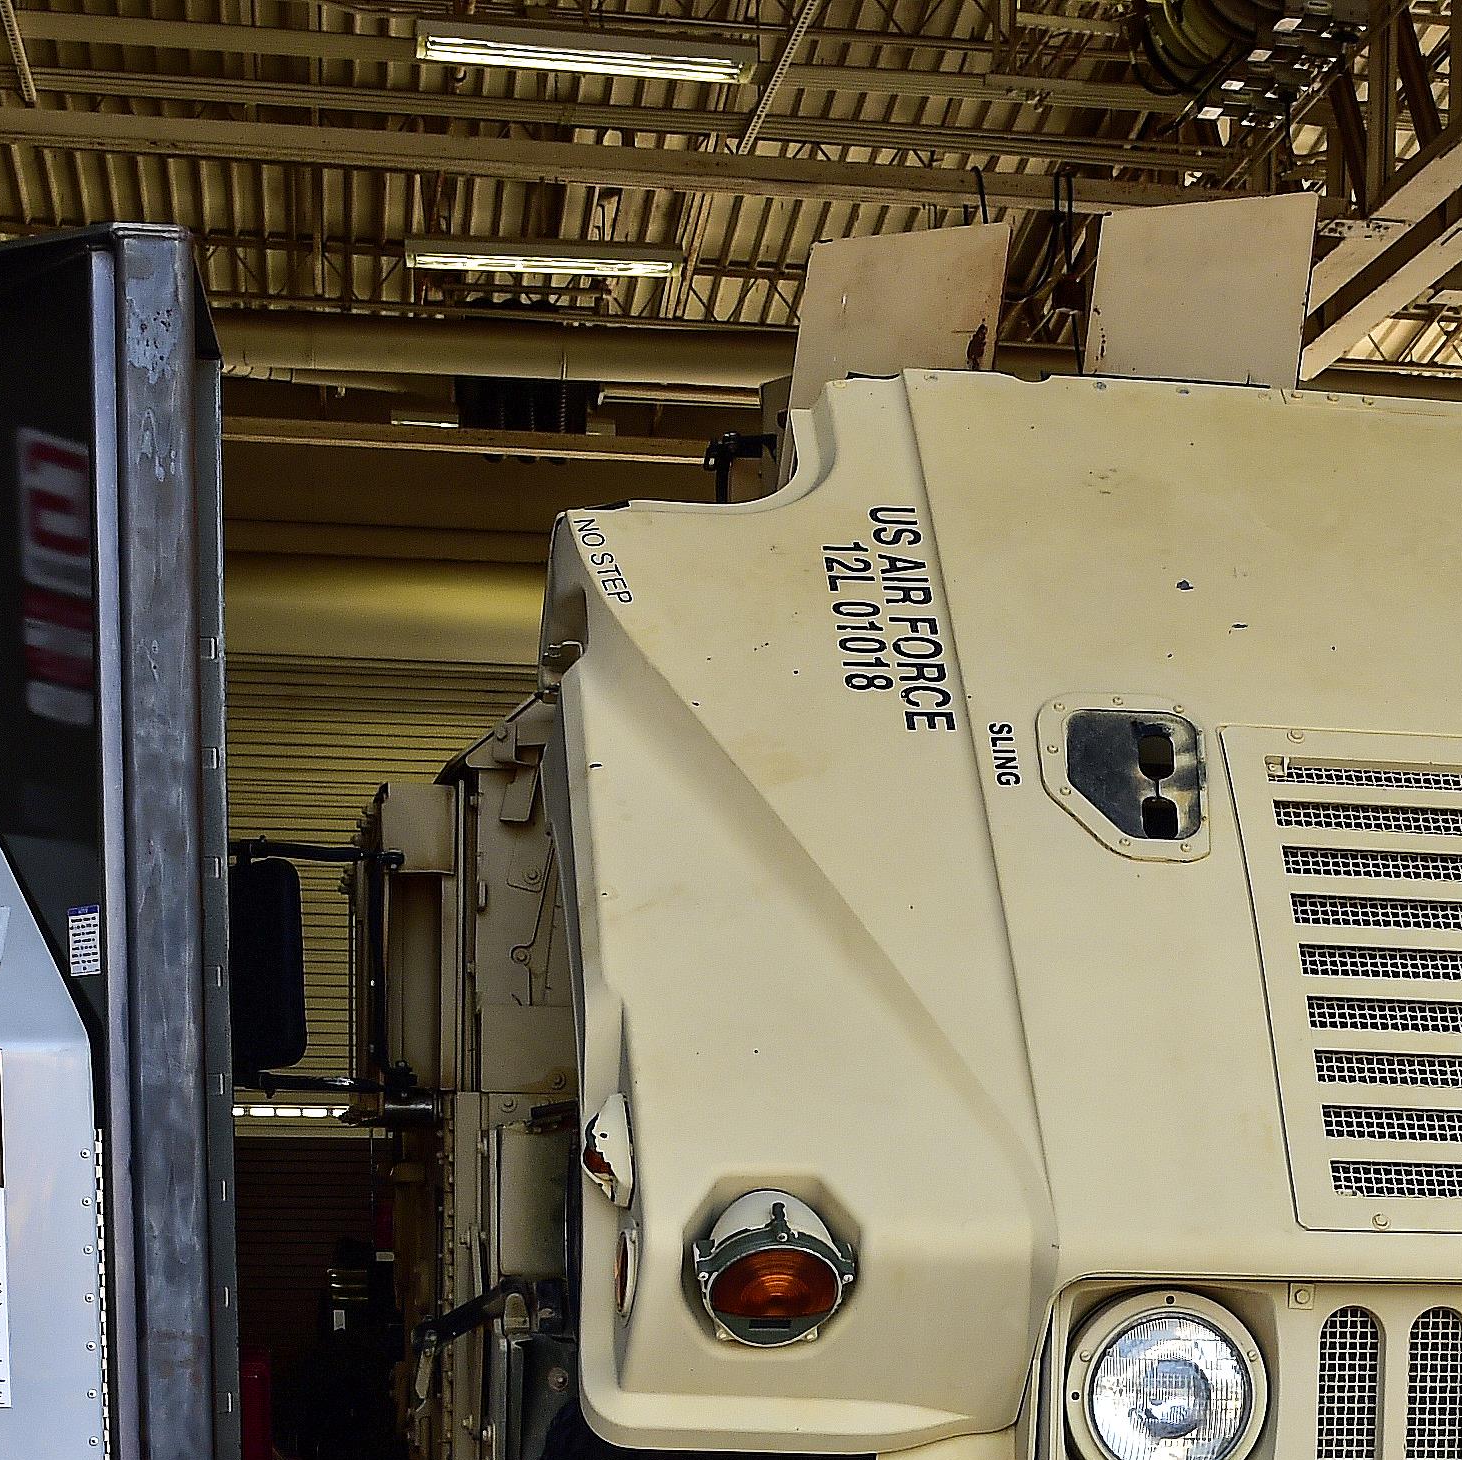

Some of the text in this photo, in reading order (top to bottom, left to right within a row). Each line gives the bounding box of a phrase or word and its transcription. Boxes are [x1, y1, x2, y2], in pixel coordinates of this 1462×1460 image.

[573, 518, 632, 606] NO STEP
[822, 540, 894, 693] 12L 01018
[868, 505, 957, 733] US AIR FORCE
[988, 721, 1022, 788] SLING
